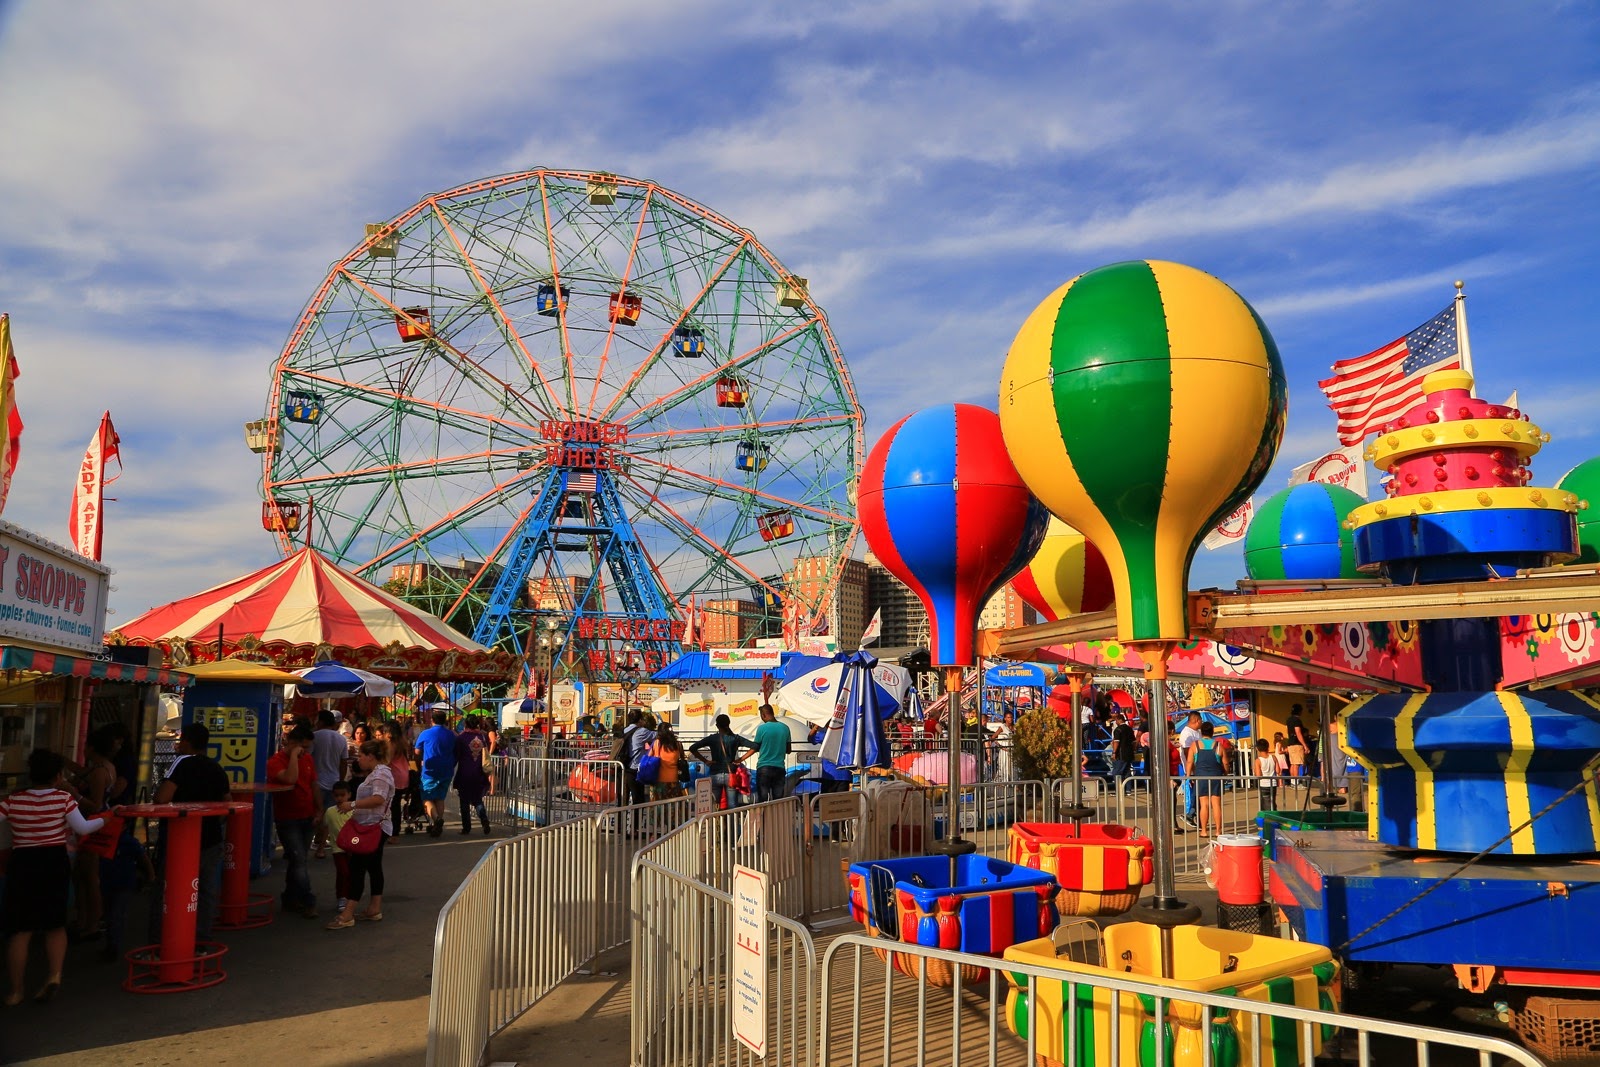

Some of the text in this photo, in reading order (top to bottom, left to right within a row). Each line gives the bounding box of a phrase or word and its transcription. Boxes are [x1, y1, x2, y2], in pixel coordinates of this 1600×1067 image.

[541, 420, 629, 444] WONDER
[545, 446, 622, 471] WHEEL
[15, 553, 87, 616] SHOPPE
[25, 608, 53, 629] churros
[57, 616, 78, 634] funnel
[77, 624, 92, 637] cake
[1201, 607, 1209, 618] 5
[577, 617, 687, 641] WONDER
[713, 651, 729, 661] Say
[744, 651, 779, 660] Cheese!
[733, 704, 753, 714] Photos
